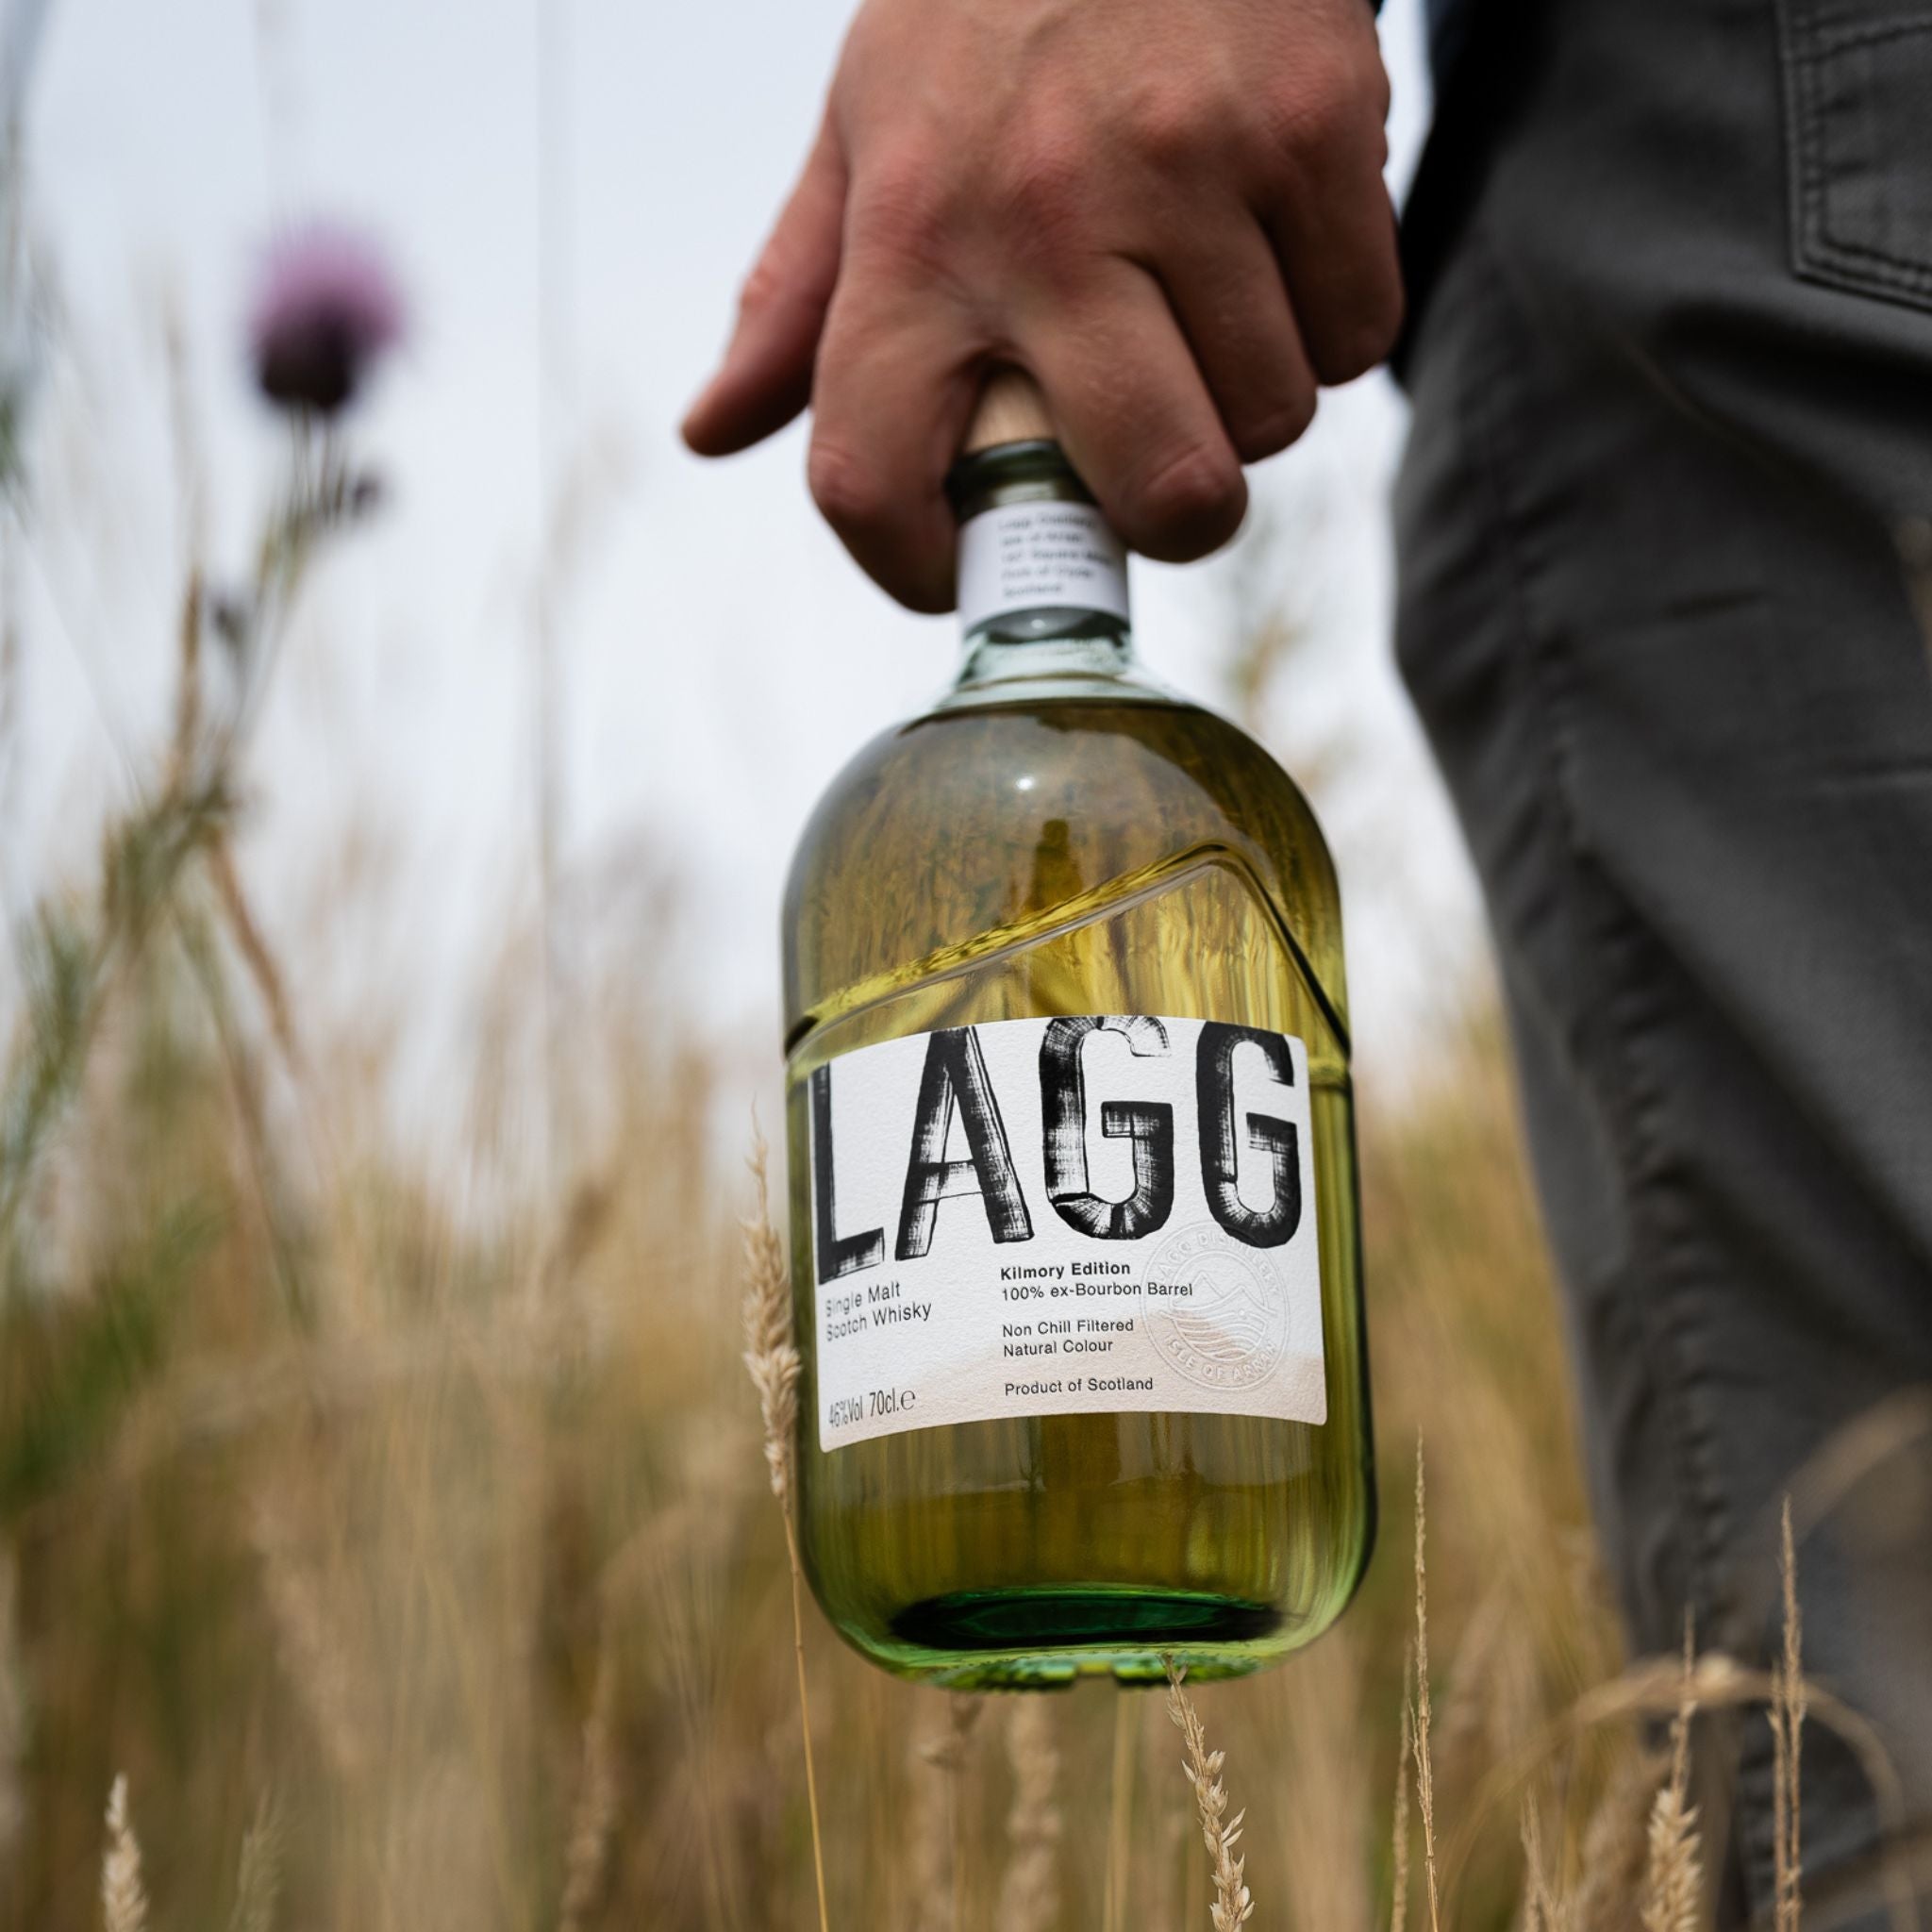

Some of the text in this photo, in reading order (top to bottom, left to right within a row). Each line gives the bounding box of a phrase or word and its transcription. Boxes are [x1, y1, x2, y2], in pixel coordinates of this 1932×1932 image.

[812, 1016, 1301, 1284] LAGG
[1000, 1261, 1130, 1281] Kilmory Edition
[825, 1281, 901, 1317] Single Malt
[1002, 1283, 1193, 1301] 100% ex-Bourbon Barrel
[826, 1301, 932, 1341] Scotch Whisky
[1003, 1319, 1134, 1337] Non Chill Filtered
[1004, 1340, 1113, 1357] Natural Colour
[1005, 1377, 1154, 1396] Product of Scotland
